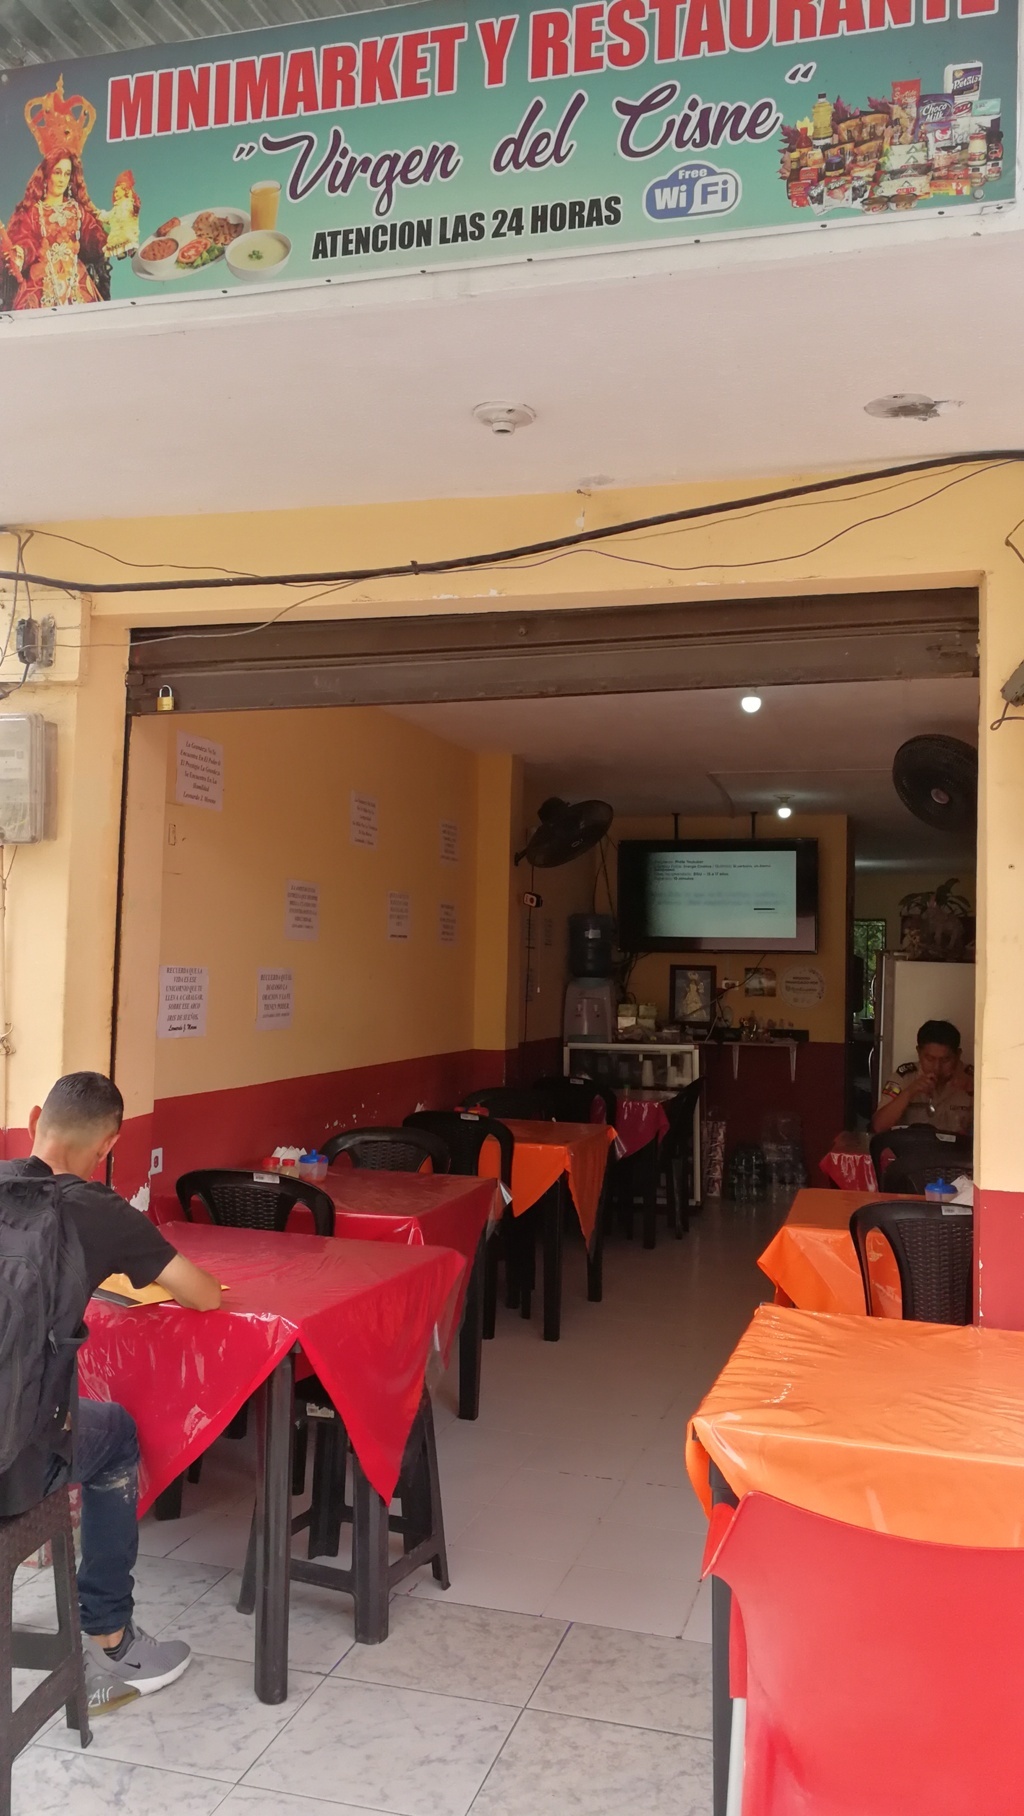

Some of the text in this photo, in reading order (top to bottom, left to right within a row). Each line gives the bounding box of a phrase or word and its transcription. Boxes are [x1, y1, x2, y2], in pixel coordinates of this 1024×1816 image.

[107, 25, 466, 140] MINIMARKET
[478, 17, 517, 86] Y
[922, 103, 948, 116] Choco
[925, 112, 944, 122] Milk
[492, 92, 585, 173] del
[678, 167, 708, 180] Free
[311, 195, 622, 261] ATENCION LAS 24 HORAS
